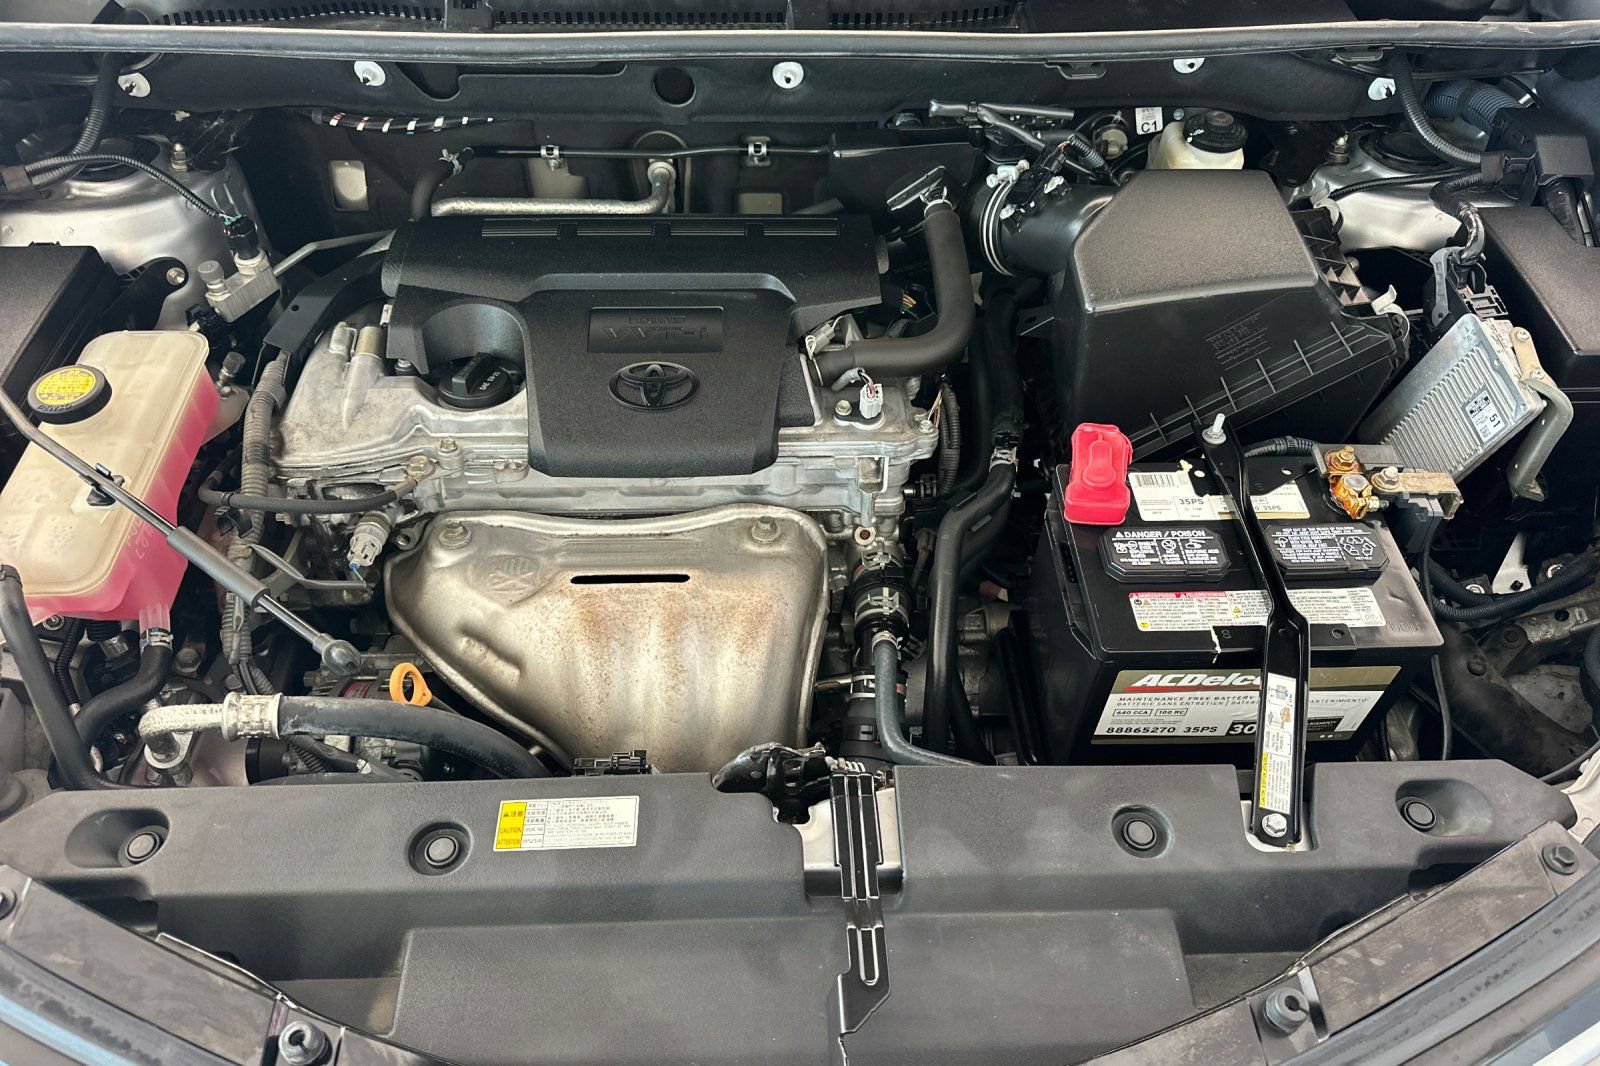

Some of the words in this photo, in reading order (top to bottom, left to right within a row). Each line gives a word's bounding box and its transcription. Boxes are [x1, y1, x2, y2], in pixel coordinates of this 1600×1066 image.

[1141, 120, 1157, 133] C1
[1489, 413, 1501, 428] 51
[1179, 498, 1205, 506] 35PS
[1106, 726, 1176, 734] 88865270
[1229, 724, 1256, 735] 30
